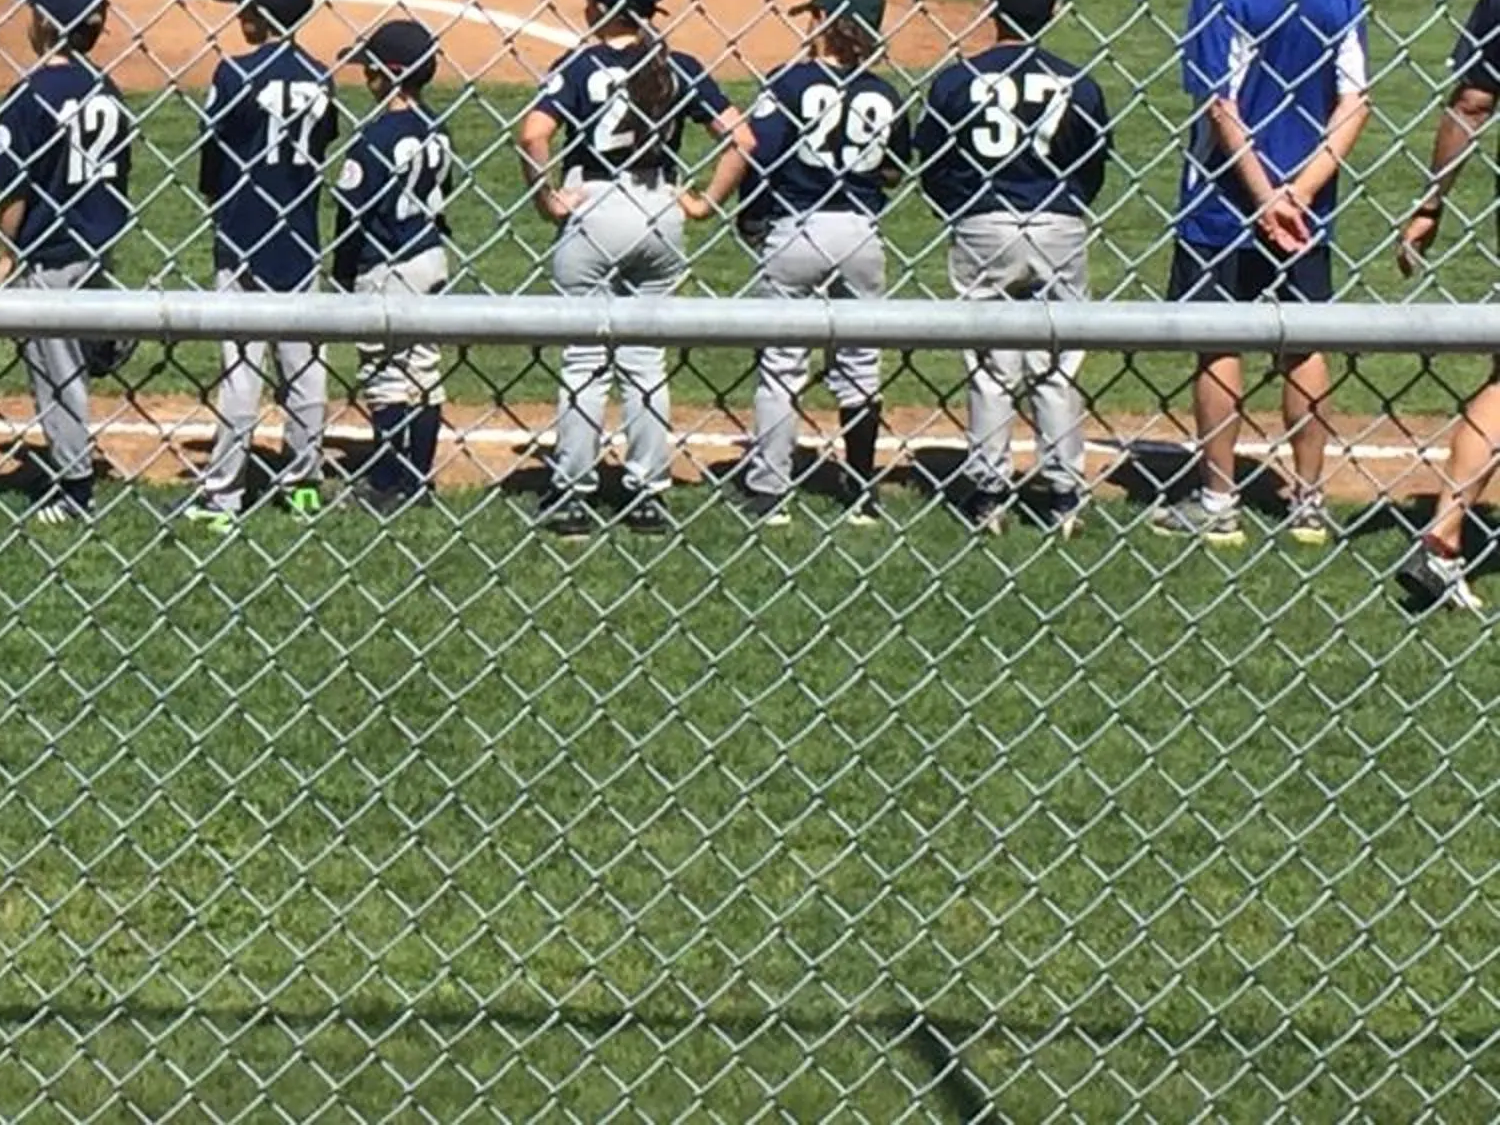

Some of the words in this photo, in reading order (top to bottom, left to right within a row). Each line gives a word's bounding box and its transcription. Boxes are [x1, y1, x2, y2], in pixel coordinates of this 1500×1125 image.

[56, 94, 120, 184] 12
[256, 79, 329, 165] 17
[798, 83, 895, 173] 29
[969, 72, 1074, 159] 37
